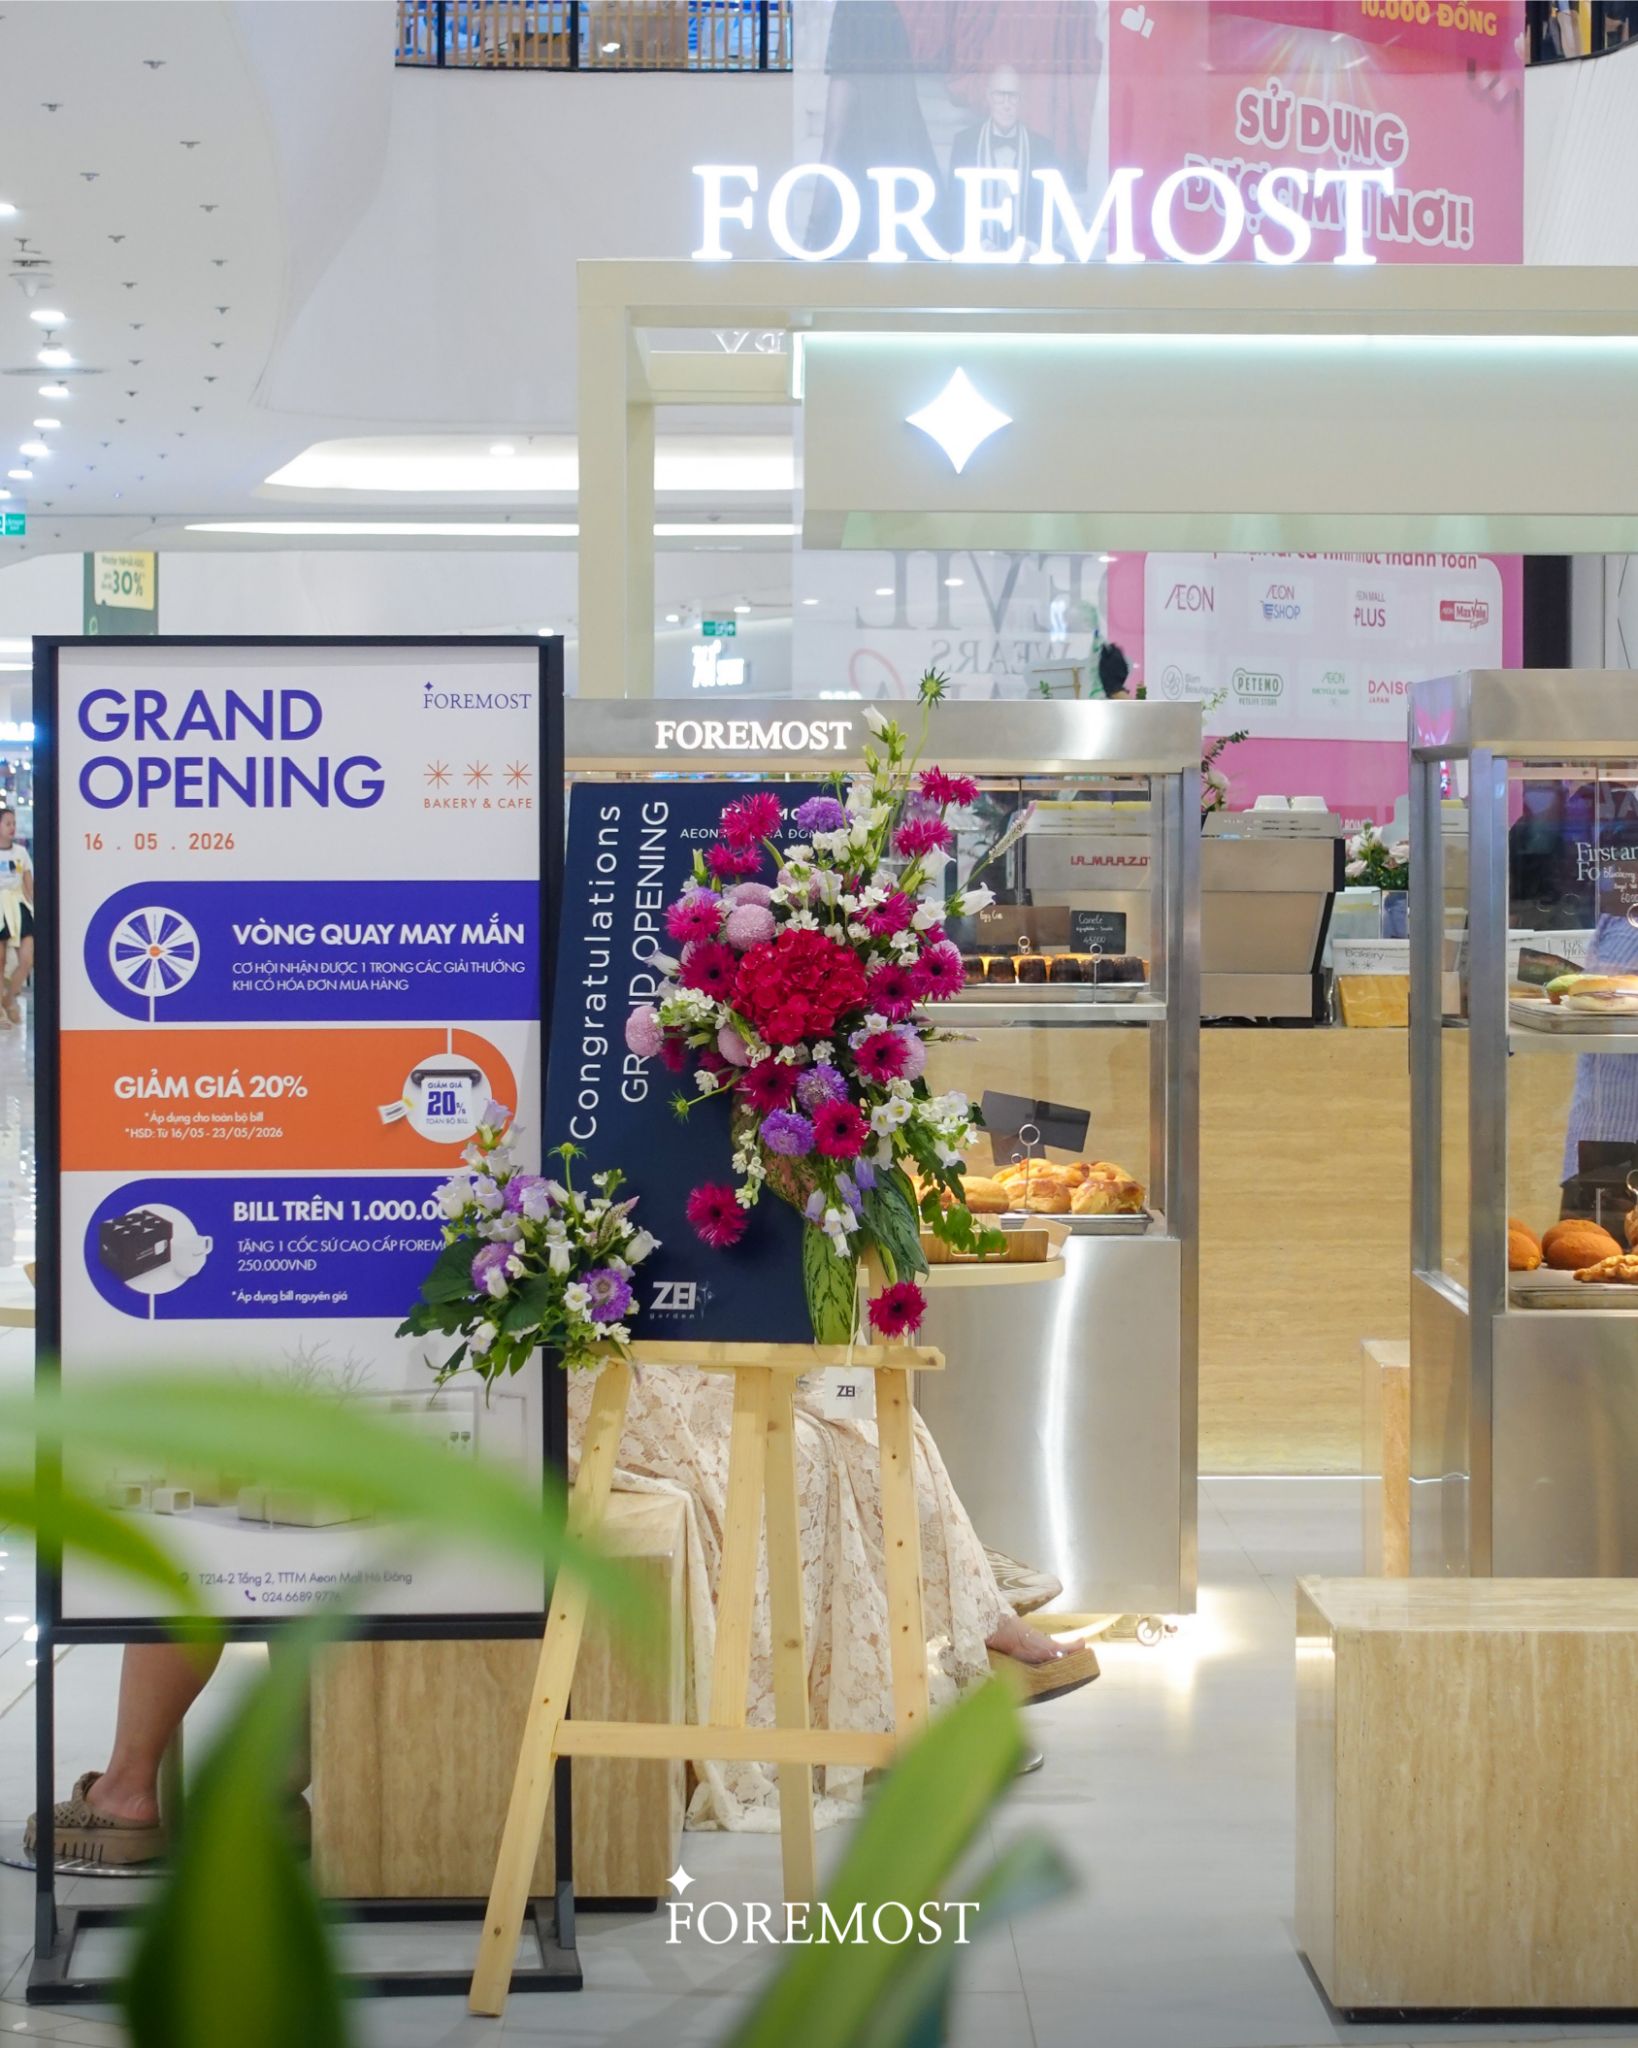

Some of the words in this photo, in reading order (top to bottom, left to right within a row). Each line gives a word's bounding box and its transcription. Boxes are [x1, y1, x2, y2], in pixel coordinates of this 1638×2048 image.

[1236, 77, 1296, 149] SỬ
[1297, 98, 1410, 168] DỤNG
[690, 164, 1397, 265] FOREMOST
[1375, 188, 1475, 251] NƠI!
[1353, 607, 1387, 628] PLUS
[1238, 676, 1279, 692] PETEMO
[423, 693, 533, 709] FOREMOST
[78, 688, 323, 742] GRAND
[654, 720, 853, 750] FOREMOST
[78, 755, 385, 809] OPENING
[424, 798, 478, 809] BAKERY
[483, 798, 492, 809] &
[498, 798, 533, 809] CAFE
[84, 832, 104, 851] 16
[133, 832, 158, 851] 05
[188, 832, 236, 851] 2026
[680, 828, 718, 840] AEON
[1574, 842, 1617, 862] First
[631, 801, 670, 961] OPENING
[232, 917, 316, 946] VÒNG
[320, 923, 395, 947] QUAY
[400, 923, 457, 945] MAY
[461, 912, 525, 945] MẮN
[232, 961, 254, 975] CƠ
[255, 959, 278, 978] HỘI
[280, 960, 318, 977] NHẬN
[320, 960, 358, 978] ĐƯỢC
[361, 961, 367, 974] 1
[370, 961, 414, 974] TRONG
[415, 959, 442, 974] CÁC
[443, 958, 469, 974] GIẢI
[471, 957, 525, 974] THƯỞNG
[569, 805, 621, 1140] Congratulations
[232, 979, 253, 991] KHI
[254, 977, 275, 992] CÓ
[277, 976, 305, 991] HÓA
[307, 978, 338, 991] ĐƠN
[339, 979, 369, 991] MUA
[371, 976, 409, 992] HÀNG
[114, 1068, 190, 1099] GIẢM
[194, 1069, 246, 1099] GIÁ
[250, 1075, 309, 1099] 20%
[427, 1091, 466, 1116] 20%
[193, 1111, 210, 1122] cho
[249, 1111, 264, 1122] bill
[171, 1127, 205, 1140] 16/05
[212, 1127, 284, 1140] 23/05/2026
[233, 1201, 279, 1222] BILL
[282, 1194, 345, 1221] TRÊN
[238, 1238, 275, 1255] TẶNG
[278, 1240, 284, 1251] 1
[287, 1235, 319, 1252] CỐC
[321, 1237, 339, 1252] SỨ
[340, 1239, 371, 1252] CAO
[372, 1235, 398, 1252] CẤP
[400, 1239, 448, 1252] FOREM
[238, 1259, 317, 1272] 250.000VNĐ
[279, 1290, 294, 1301] bill
[295, 1290, 330, 1304] nguyên
[332, 1289, 348, 1304] giá
[278, 1571, 306, 1584] TTTM
[309, 1572, 337, 1583] Aeon
